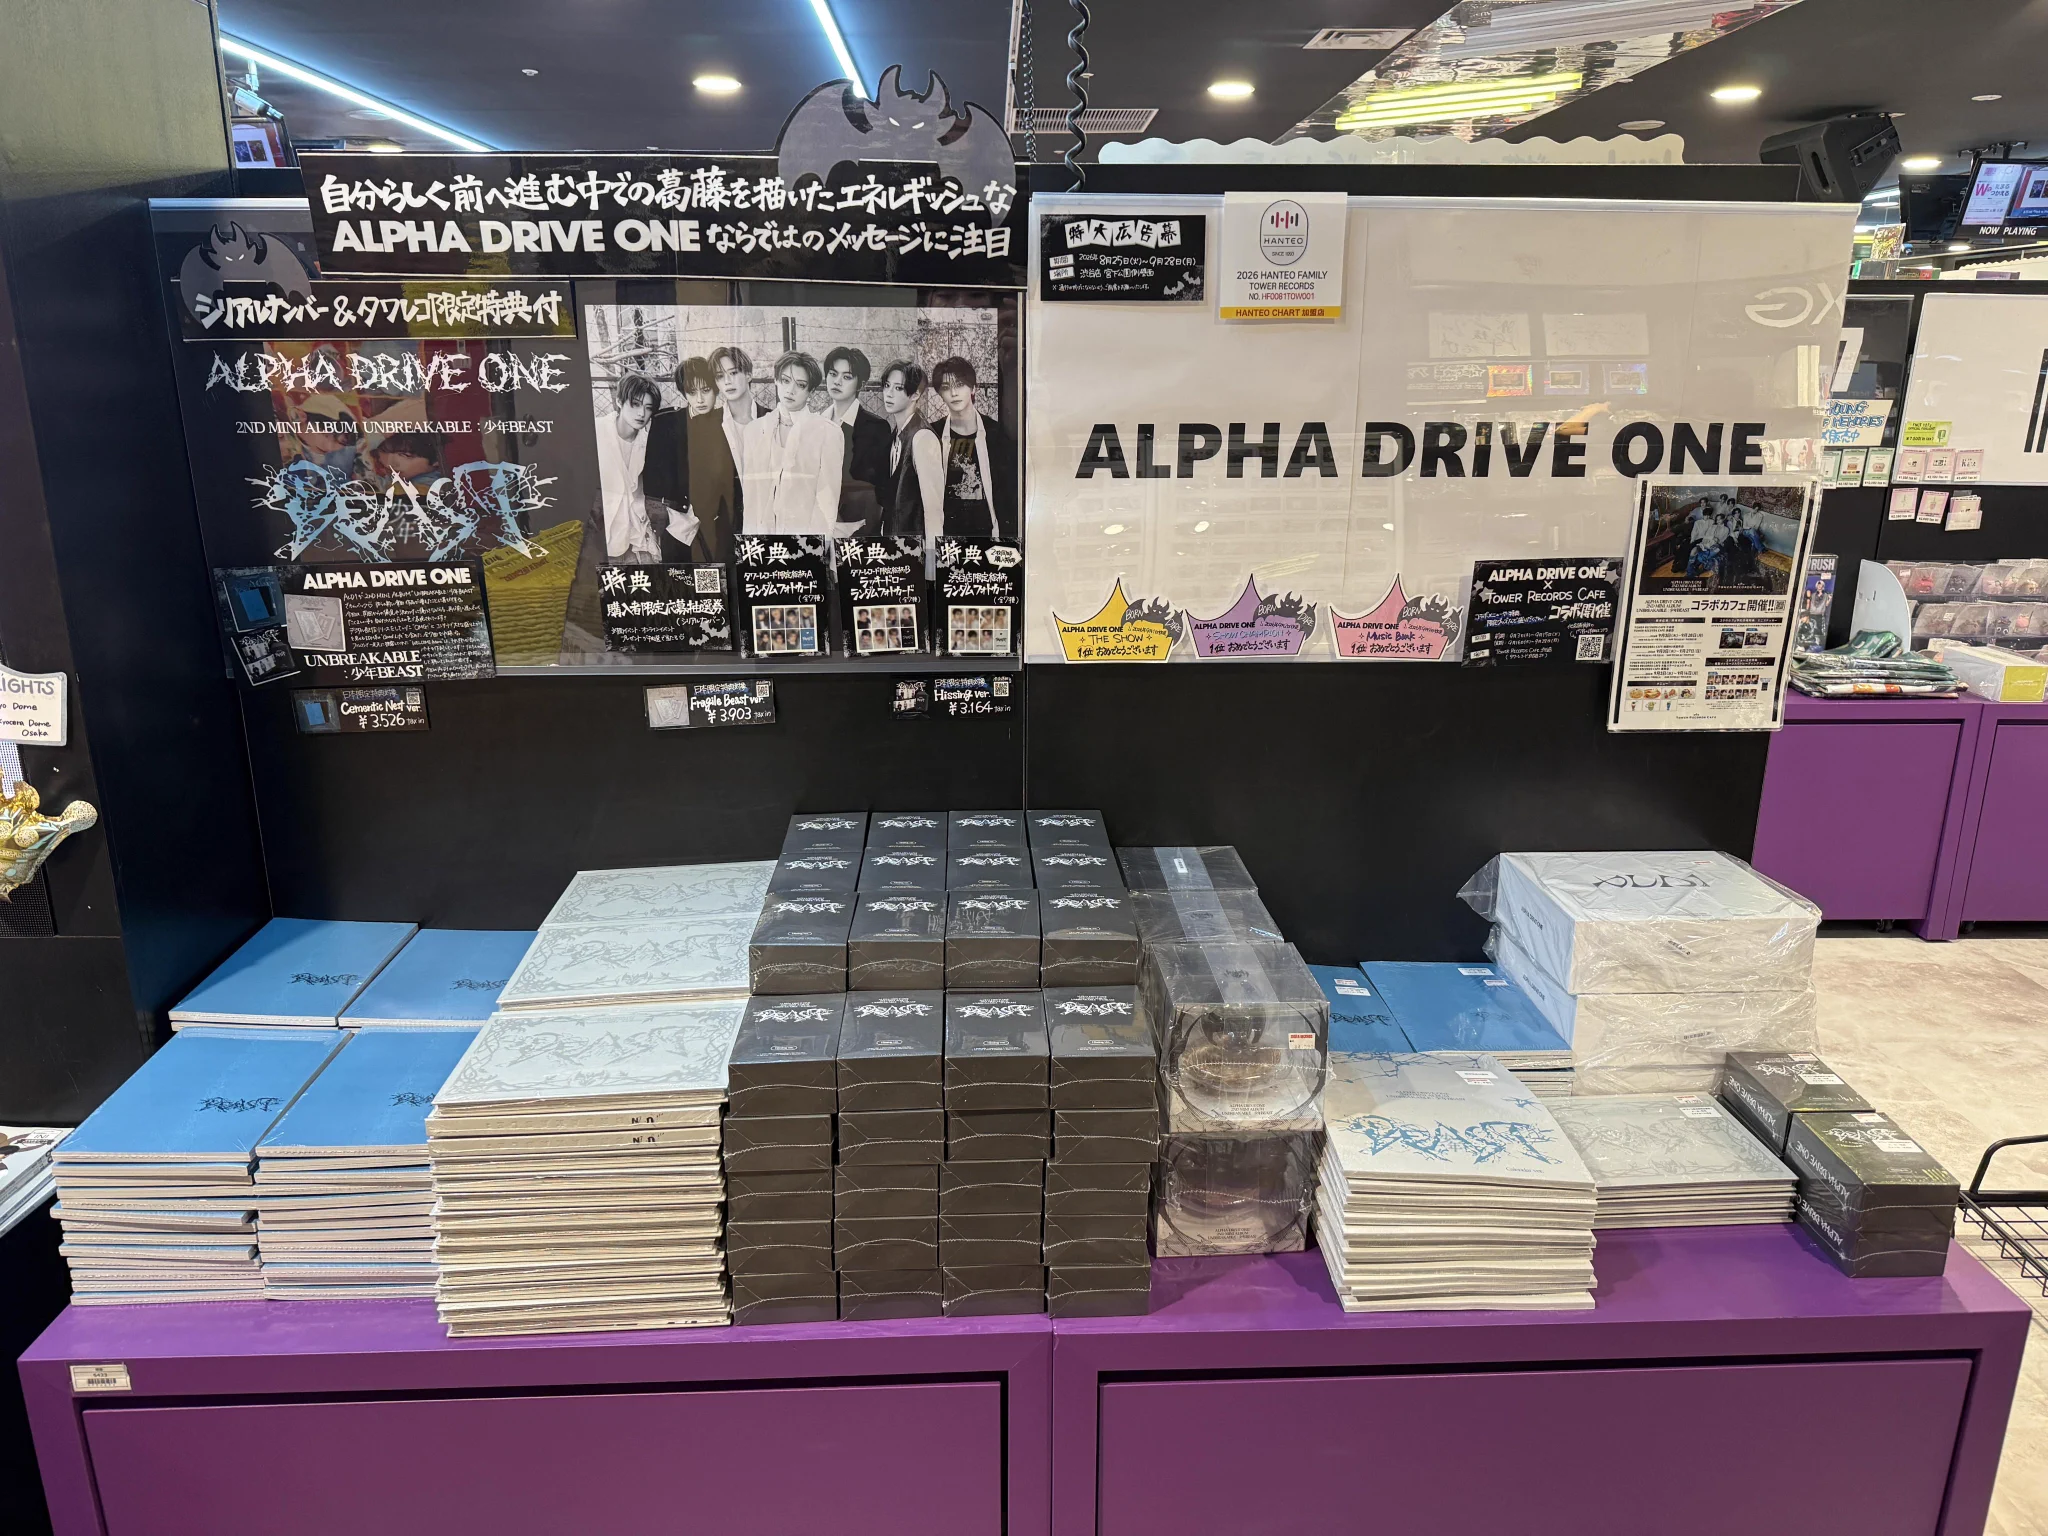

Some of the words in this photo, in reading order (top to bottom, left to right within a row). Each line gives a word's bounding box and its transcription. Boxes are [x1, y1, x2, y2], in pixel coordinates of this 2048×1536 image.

[1068, 222, 1177, 244] 特大広告幕
[1979, 226, 2000, 235] NOW
[2003, 226, 2038, 236] PLAYING
[332, 220, 472, 252] ALPHA
[479, 220, 605, 252] DRIVE
[613, 219, 700, 252] ONE
[706, 221, 1011, 259] ならではのメッセージに注目
[1237, 271, 1259, 280] 2026
[1260, 271, 1296, 280] HANTEO
[1298, 271, 1328, 279] FAMILY
[1249, 282, 1277, 290] TOWER
[1279, 282, 1315, 290] RECORDS
[1235, 309, 1270, 317] HANTEO
[1272, 309, 1300, 317] CHART
[1302, 309, 1325, 317] 加盟店
[205, 350, 344, 394] ALPHA
[346, 350, 471, 394] DRIVE
[478, 353, 572, 394] ONE
[236, 421, 266, 434] 2ND
[268, 421, 302, 434] MINI
[305, 421, 358, 434] ALBUM
[363, 421, 472, 433] UNBREAKABLE
[1075, 422, 1339, 479] ALPHA
[1360, 422, 1589, 478] DRIVE
[1610, 422, 1766, 478] ONE
[740, 537, 789, 567] 特典
[840, 538, 887, 567] 特典
[940, 540, 982, 567] 特典
[303, 572, 369, 590] ALPHA
[370, 570, 428, 588] DRIVE
[430, 568, 471, 585] ONE
[948, 571, 1008, 583] 渋谷店限定絵柄
[1488, 567, 1533, 582] ALPHA
[1536, 566, 1576, 580] DRIVE
[1578, 566, 1606, 579] ONE
[601, 567, 652, 596] 特典
[860, 575, 906, 588] ラッキードロー
[745, 580, 817, 598] ランダムフォトカード
[850, 584, 915, 600] ランダムフォトカード
[943, 582, 1013, 598] ランダムフォトカード
[1485, 592, 1523, 604] TOWER
[1527, 590, 1573, 604] RECORDS
[1577, 587, 1606, 601] CAFE
[607, 598, 725, 618] 購入者限定応募抽選券
[1258, 603, 1277, 616] BORN
[1402, 606, 1421, 617] BORN
[1548, 601, 1612, 621] コラボ開催
[1690, 599, 1774, 612] コラボカフェ開催!!
[1125, 608, 1144, 621] BORN
[1088, 634, 1110, 646] THE
[1113, 633, 1144, 643] SHOW
[1366, 631, 1393, 641] Music
[1395, 632, 1415, 641] Bank
[1096, 644, 1158, 657] おめでとうございます
[1227, 639, 1290, 653] おめでとうございます
[1369, 642, 1433, 654] おめでとうございます
[303, 650, 422, 668] UNBREAKABLE
[0, 678, 55, 695] IGHTS
[934, 689, 973, 702] Hissing
[13, 702, 38, 710] Dome
[340, 702, 383, 715] Cementic
[385, 700, 405, 712] Nest
[690, 694, 722, 713] Fragile
[723, 693, 749, 707] Beast
[29, 719, 51, 727] Dome
[22, 729, 48, 737] Osaka
